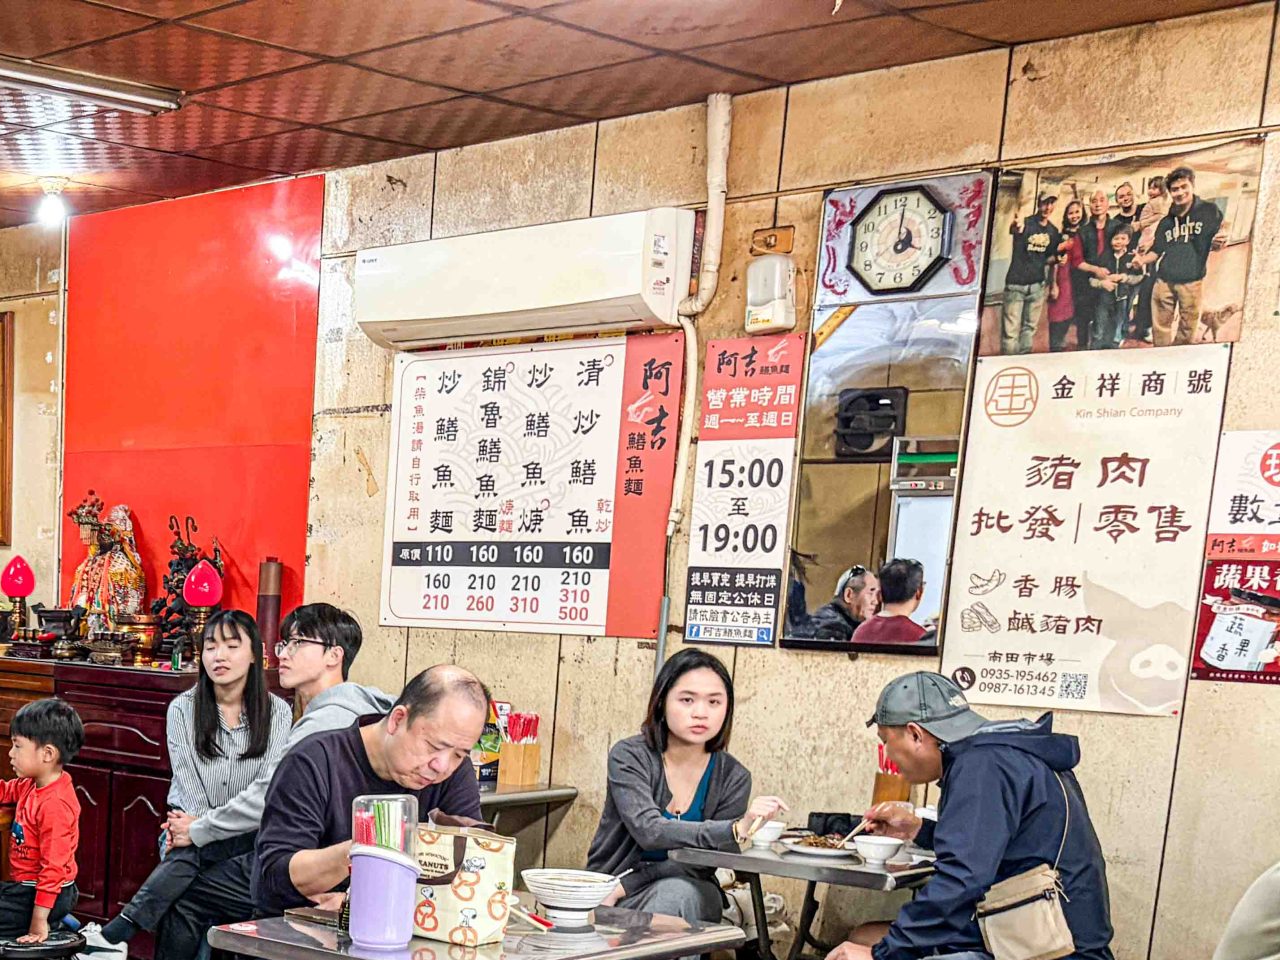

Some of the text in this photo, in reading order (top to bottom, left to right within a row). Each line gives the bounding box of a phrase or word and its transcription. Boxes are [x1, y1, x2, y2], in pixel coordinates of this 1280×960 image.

[717, 345, 758, 377] 阿吉
[706, 384, 796, 410] 營業時間
[1051, 369, 1213, 399] 金祥商號
[642, 358, 672, 450] 阿吉
[1075, 406, 1183, 418] Kin Shian Company
[429, 370, 462, 534] 炒鱔魚麵
[472, 366, 506, 533] 錦魯鱔魚麵
[566, 359, 604, 535] 清炒鱔魚
[624, 432, 646, 495] 鱔魚麵
[704, 458, 784, 488] 15:00
[1025, 452, 1150, 490] 豬肉
[727, 497, 750, 517] 至
[970, 504, 1192, 544] 批發 零售
[698, 523, 778, 554] 19:00
[425, 544, 453, 562] 110
[470, 545, 499, 563] 160
[513, 545, 543, 564] 160
[562, 546, 594, 565] 160
[424, 571, 591, 592] 160 210 210 210
[1012, 574, 1081, 598] 香腸
[422, 588, 590, 613] 210 260 310 310
[689, 590, 775, 606] 無固定公休日
[558, 606, 589, 622] 500
[1007, 610, 1103, 635] 鹹豬肉
[980, 668, 1057, 683] 0935-195462
[978, 682, 1056, 697] 0987-161345
